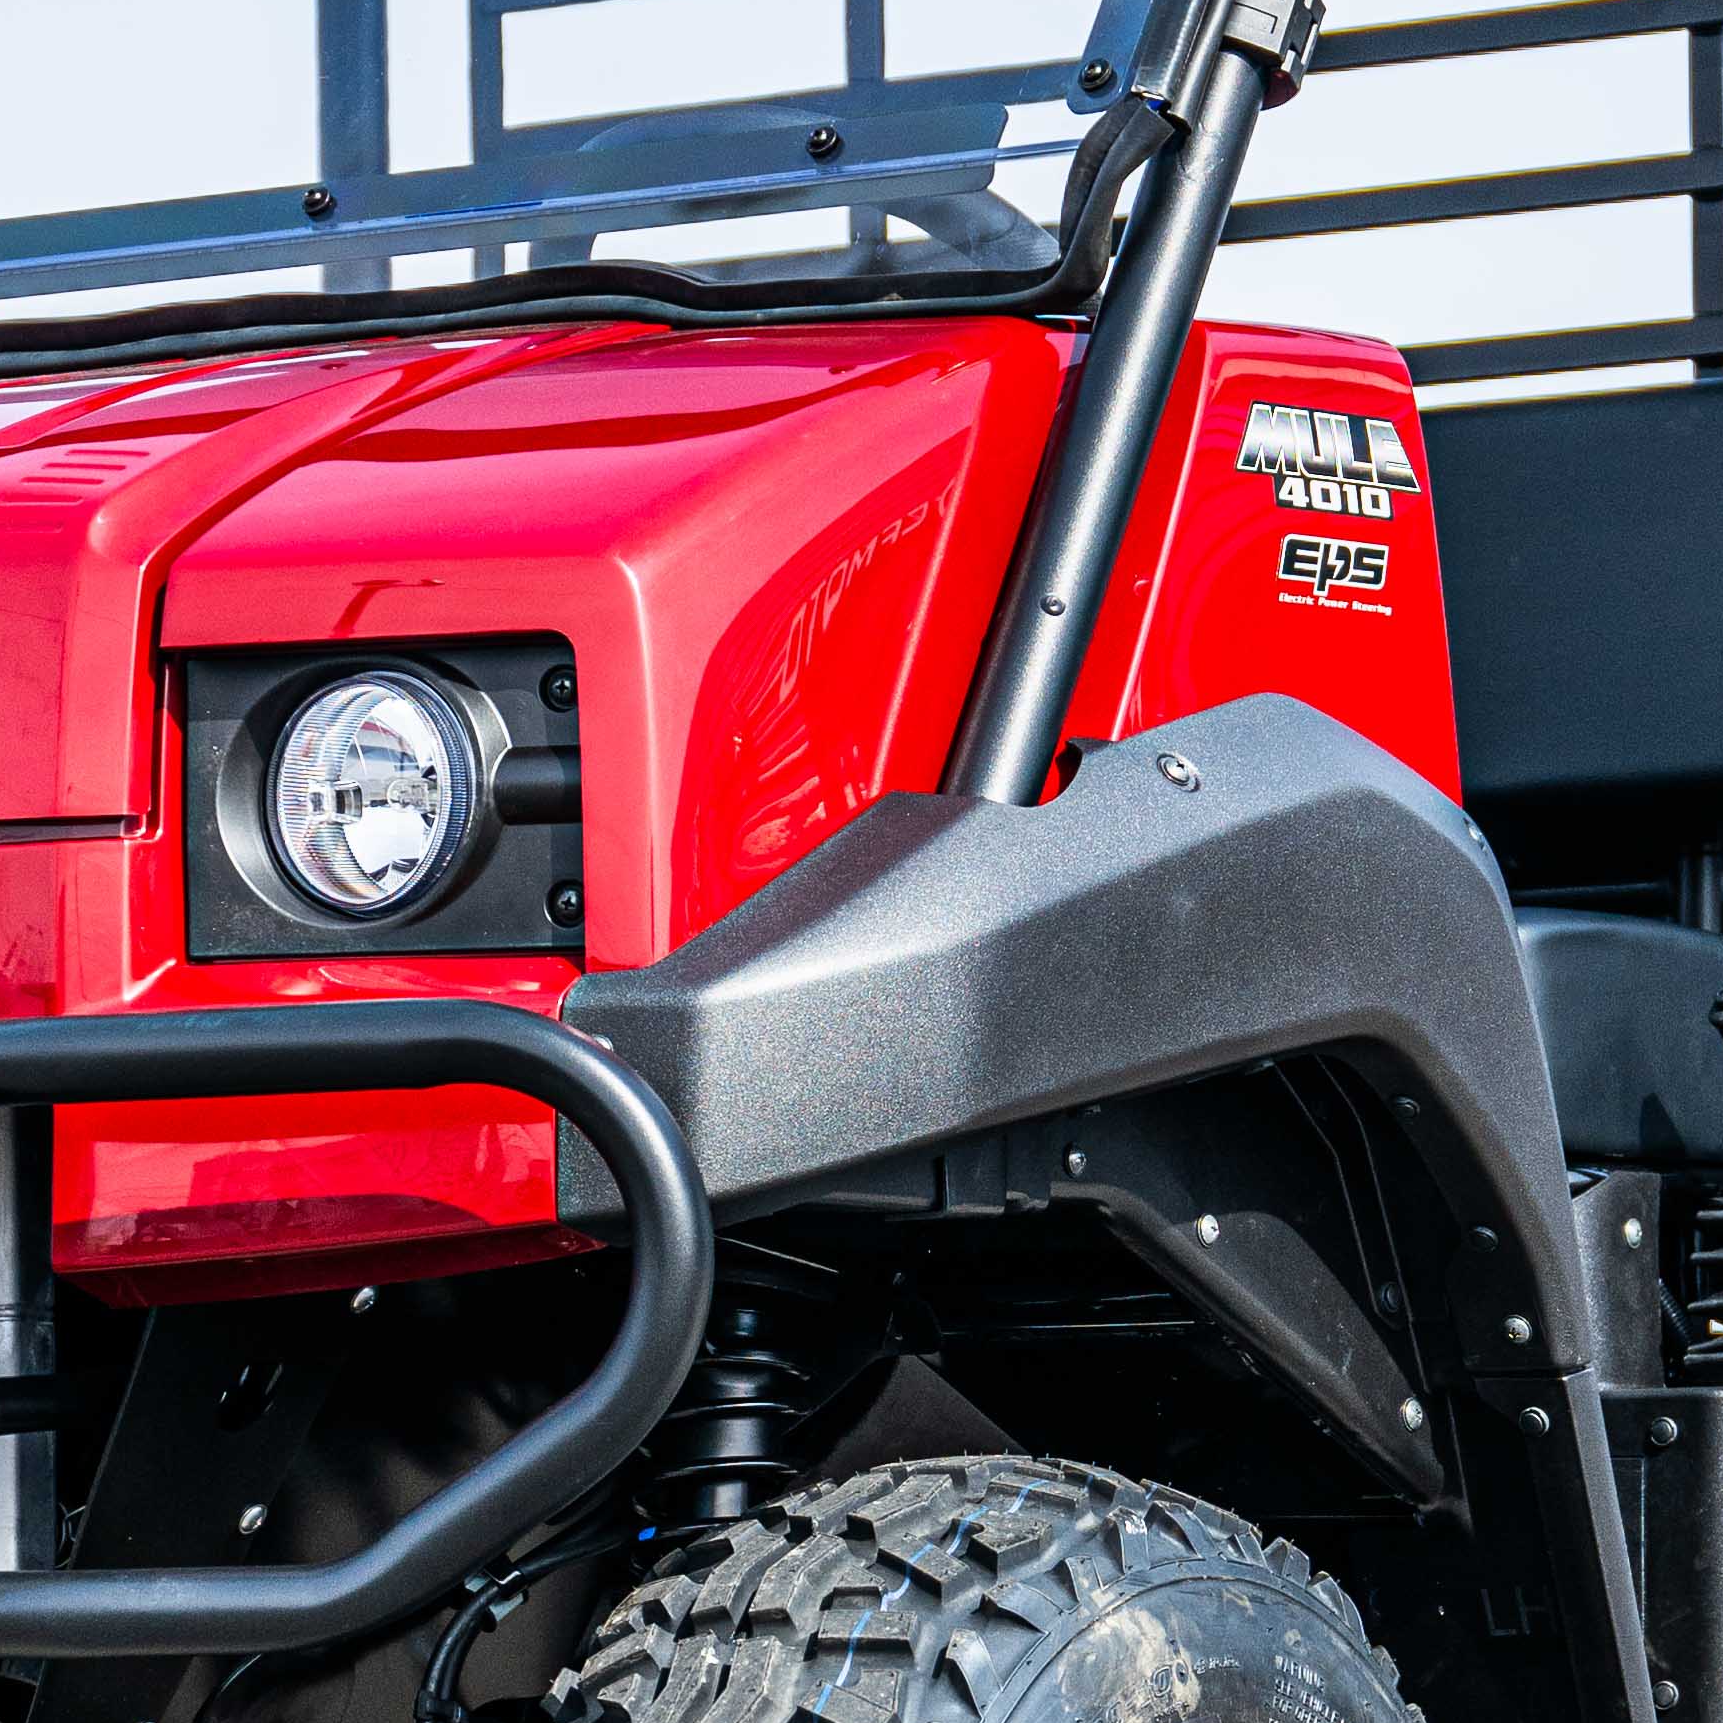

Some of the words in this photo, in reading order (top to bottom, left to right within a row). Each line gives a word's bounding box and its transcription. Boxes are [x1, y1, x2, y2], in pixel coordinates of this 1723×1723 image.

[1236, 399, 1421, 493] MULE
[1278, 479, 1391, 519] 4010
[1278, 592, 1315, 606] Electric
[1318, 596, 1349, 609] Power
[1351, 600, 1393, 616] Steering
